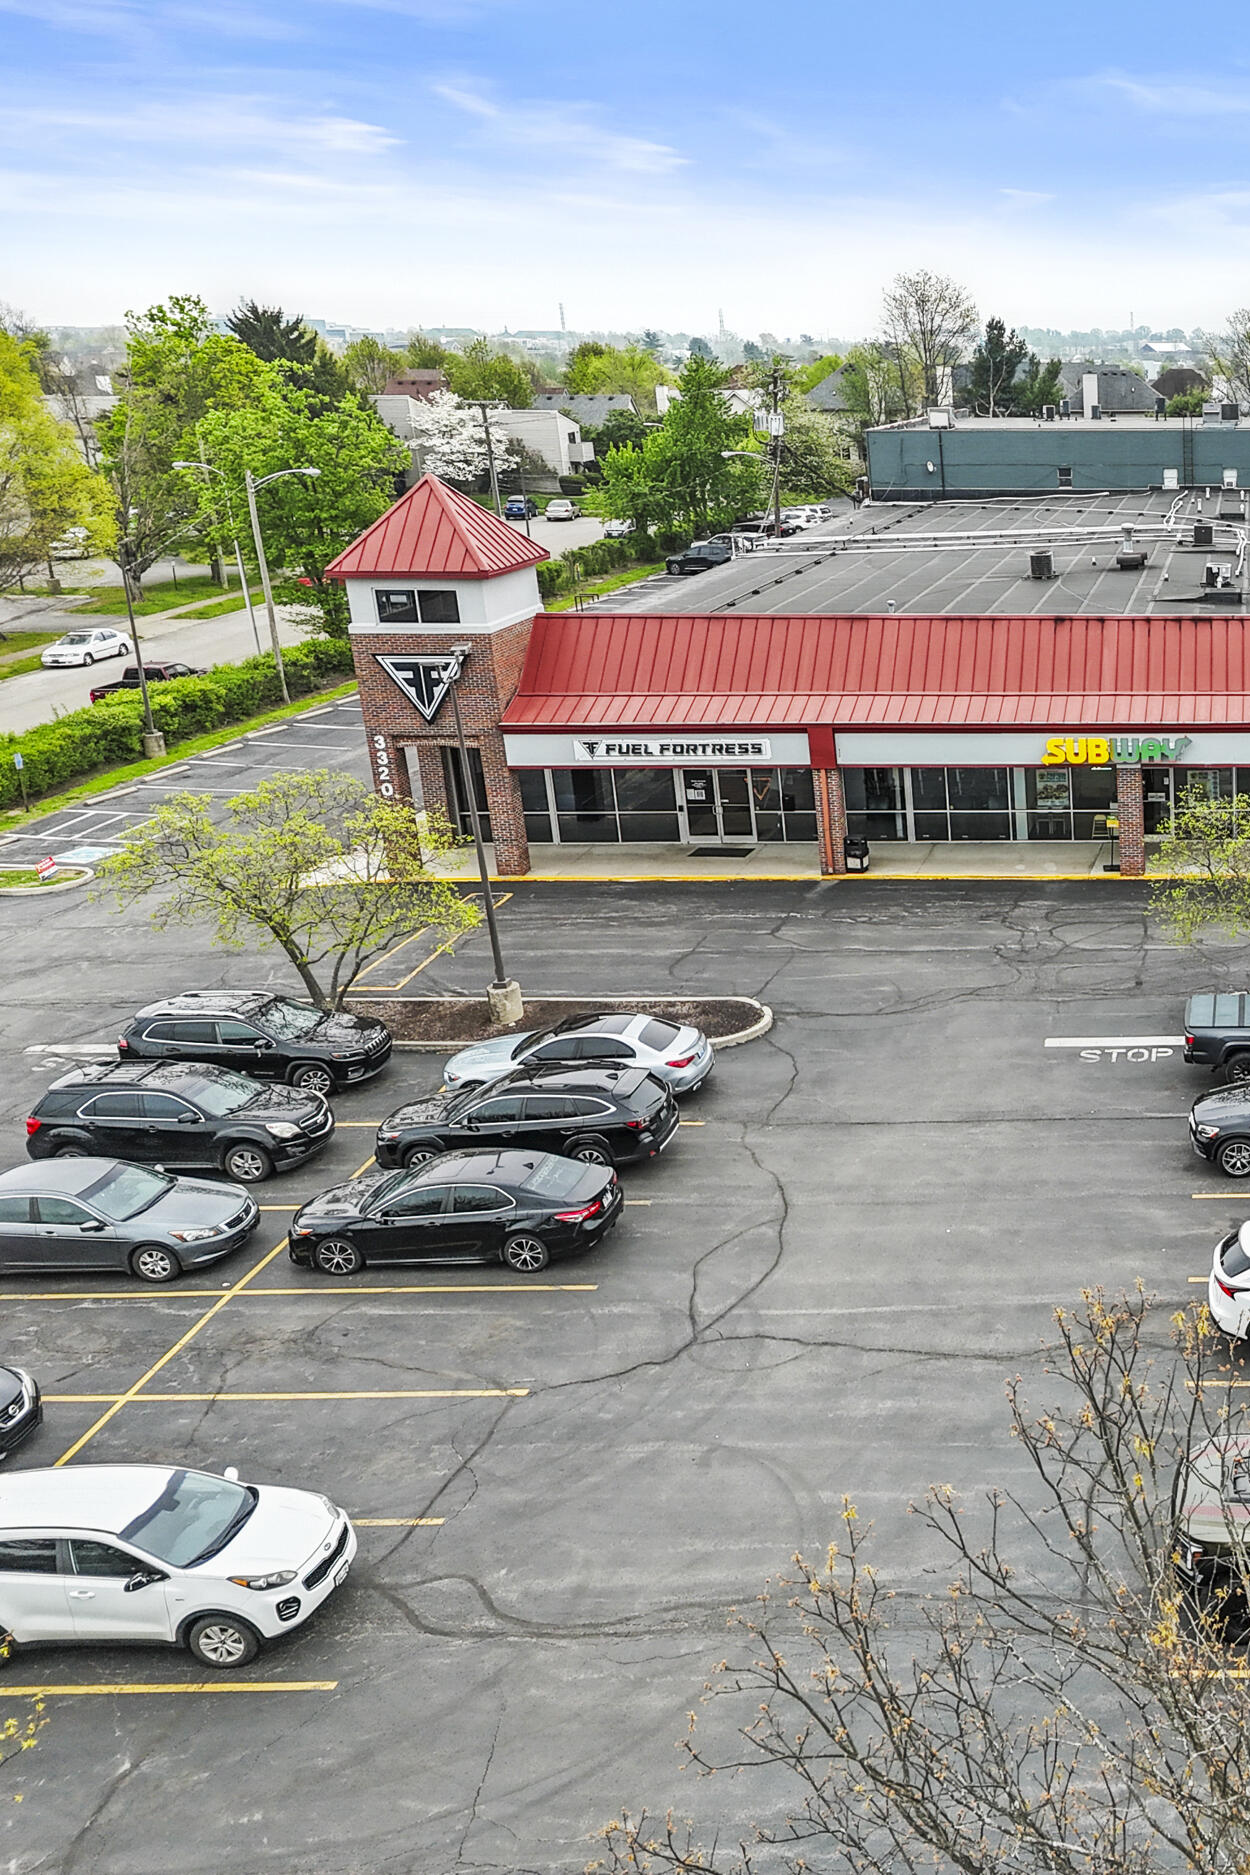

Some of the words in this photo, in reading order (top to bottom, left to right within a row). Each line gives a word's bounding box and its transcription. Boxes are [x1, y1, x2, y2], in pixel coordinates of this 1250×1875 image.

[605, 743, 653, 755] FUEL
[659, 743, 763, 755] FORTRESS
[1041, 736, 1192, 766] SUBWAY
[373, 735, 394, 796] 3320
[1079, 1048, 1174, 1063] STOP
